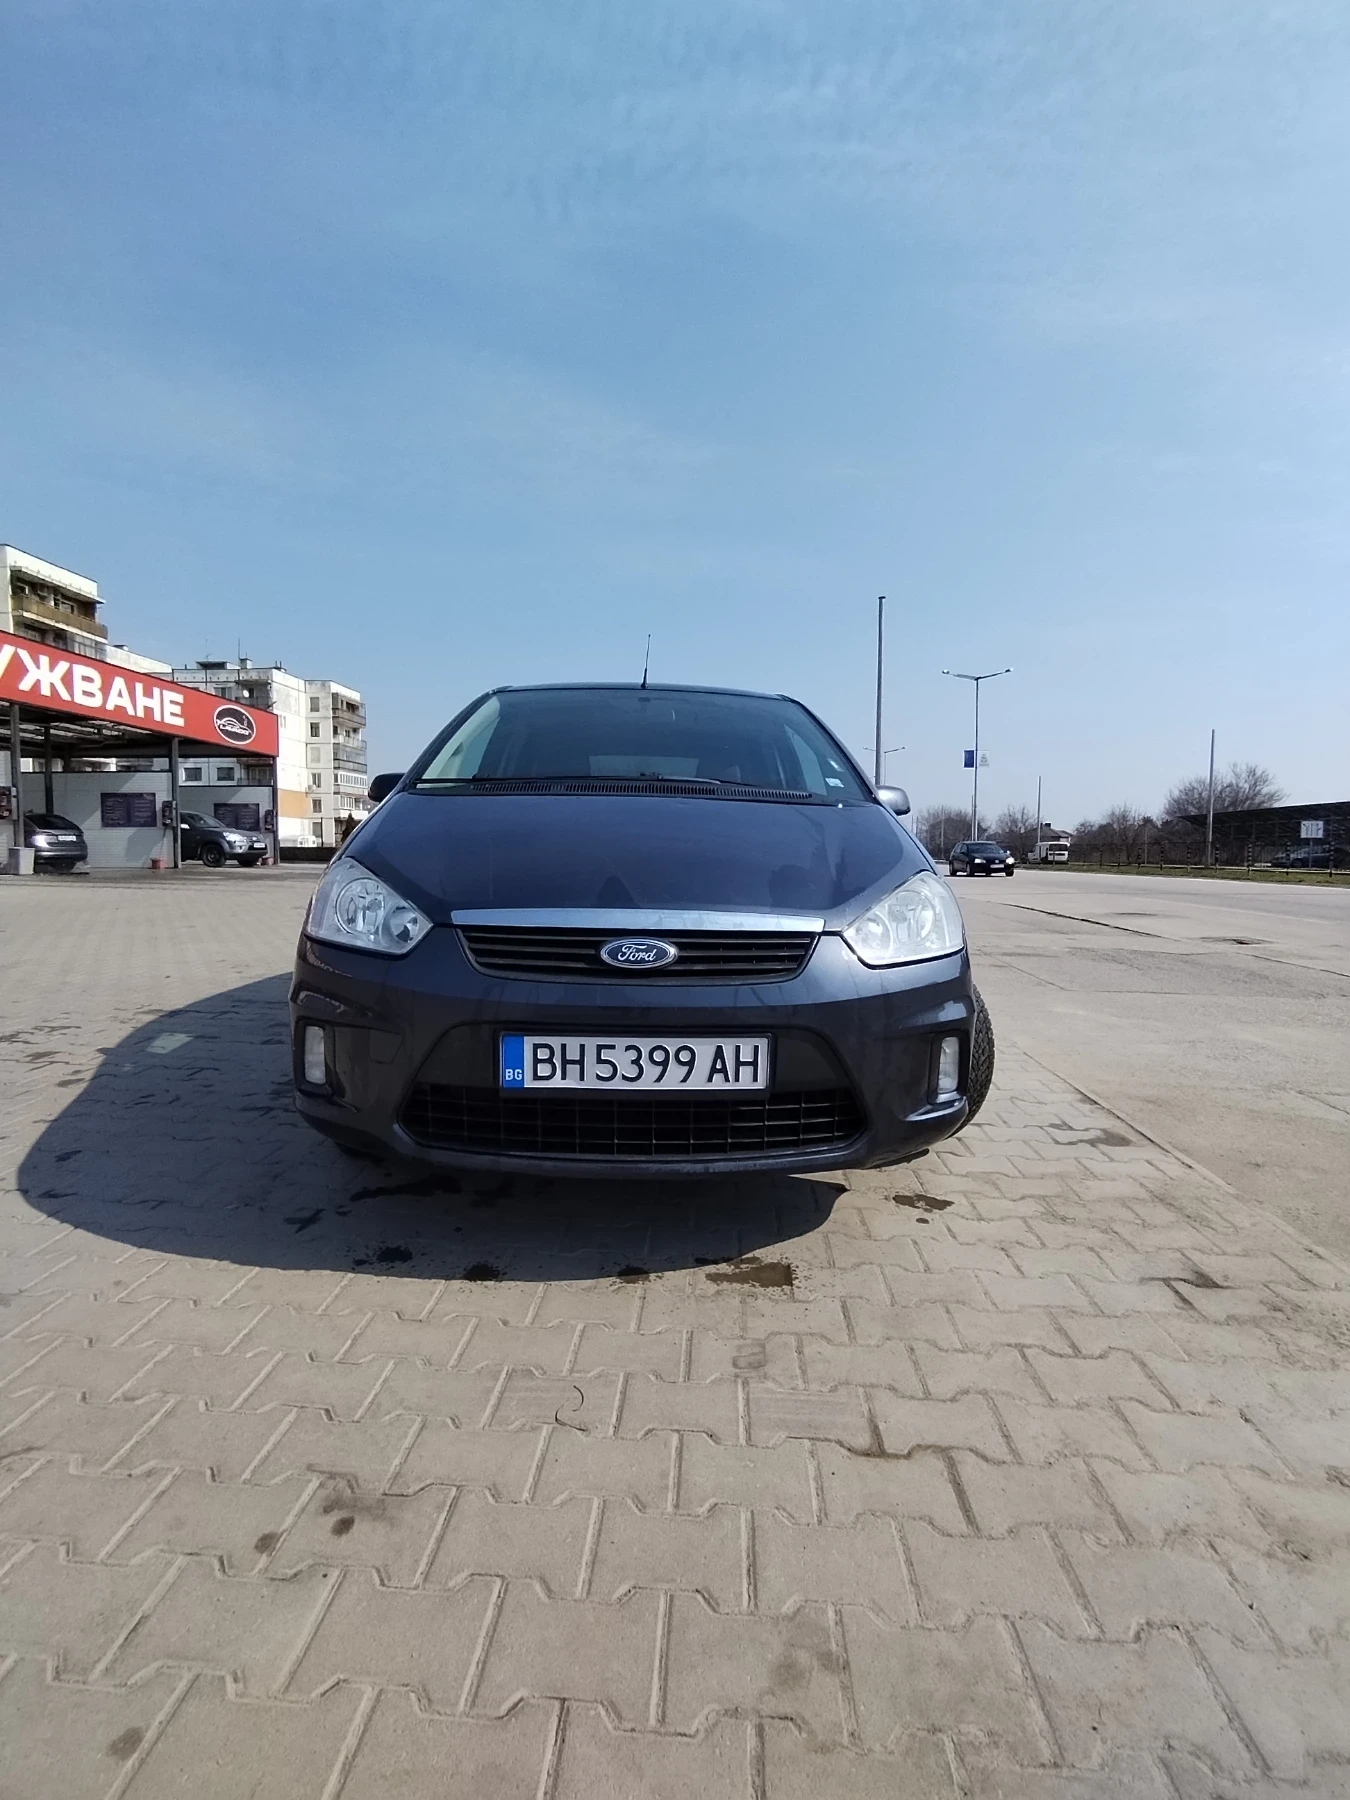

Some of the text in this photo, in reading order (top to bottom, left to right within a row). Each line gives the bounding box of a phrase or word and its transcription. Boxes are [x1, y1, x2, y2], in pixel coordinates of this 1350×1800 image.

[617, 944, 657, 961] Ford
[532, 1043, 760, 1083] BH 5399 AH
[505, 1068, 523, 1080] BG
